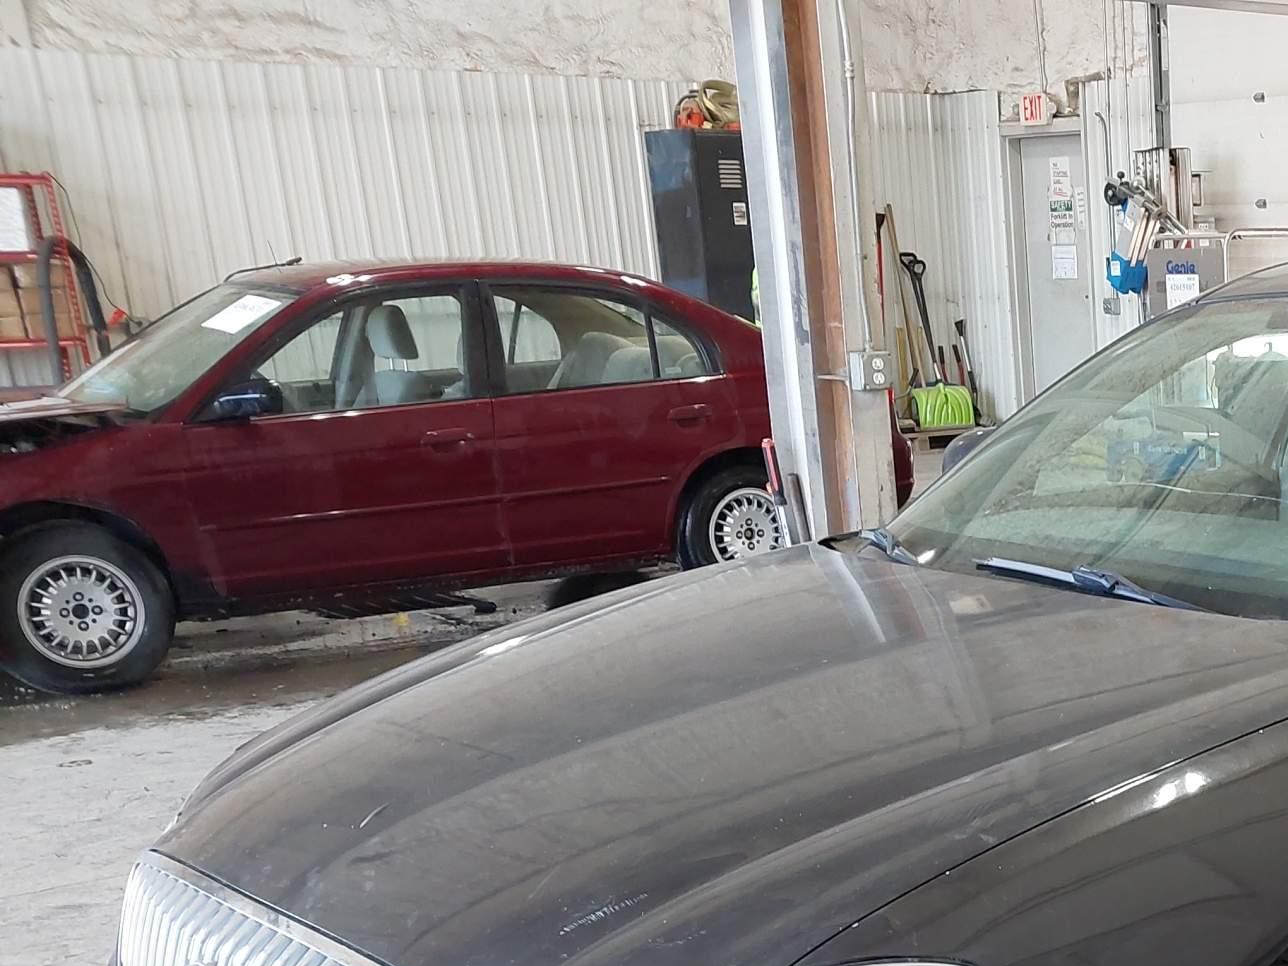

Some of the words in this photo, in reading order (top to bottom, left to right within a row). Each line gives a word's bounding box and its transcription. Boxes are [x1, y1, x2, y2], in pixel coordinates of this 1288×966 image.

[1023, 95, 1041, 120] EXIT
[1050, 200, 1073, 209] SAFETY
[1051, 221, 1073, 229] Operation
[1166, 260, 1195, 274] Genie
